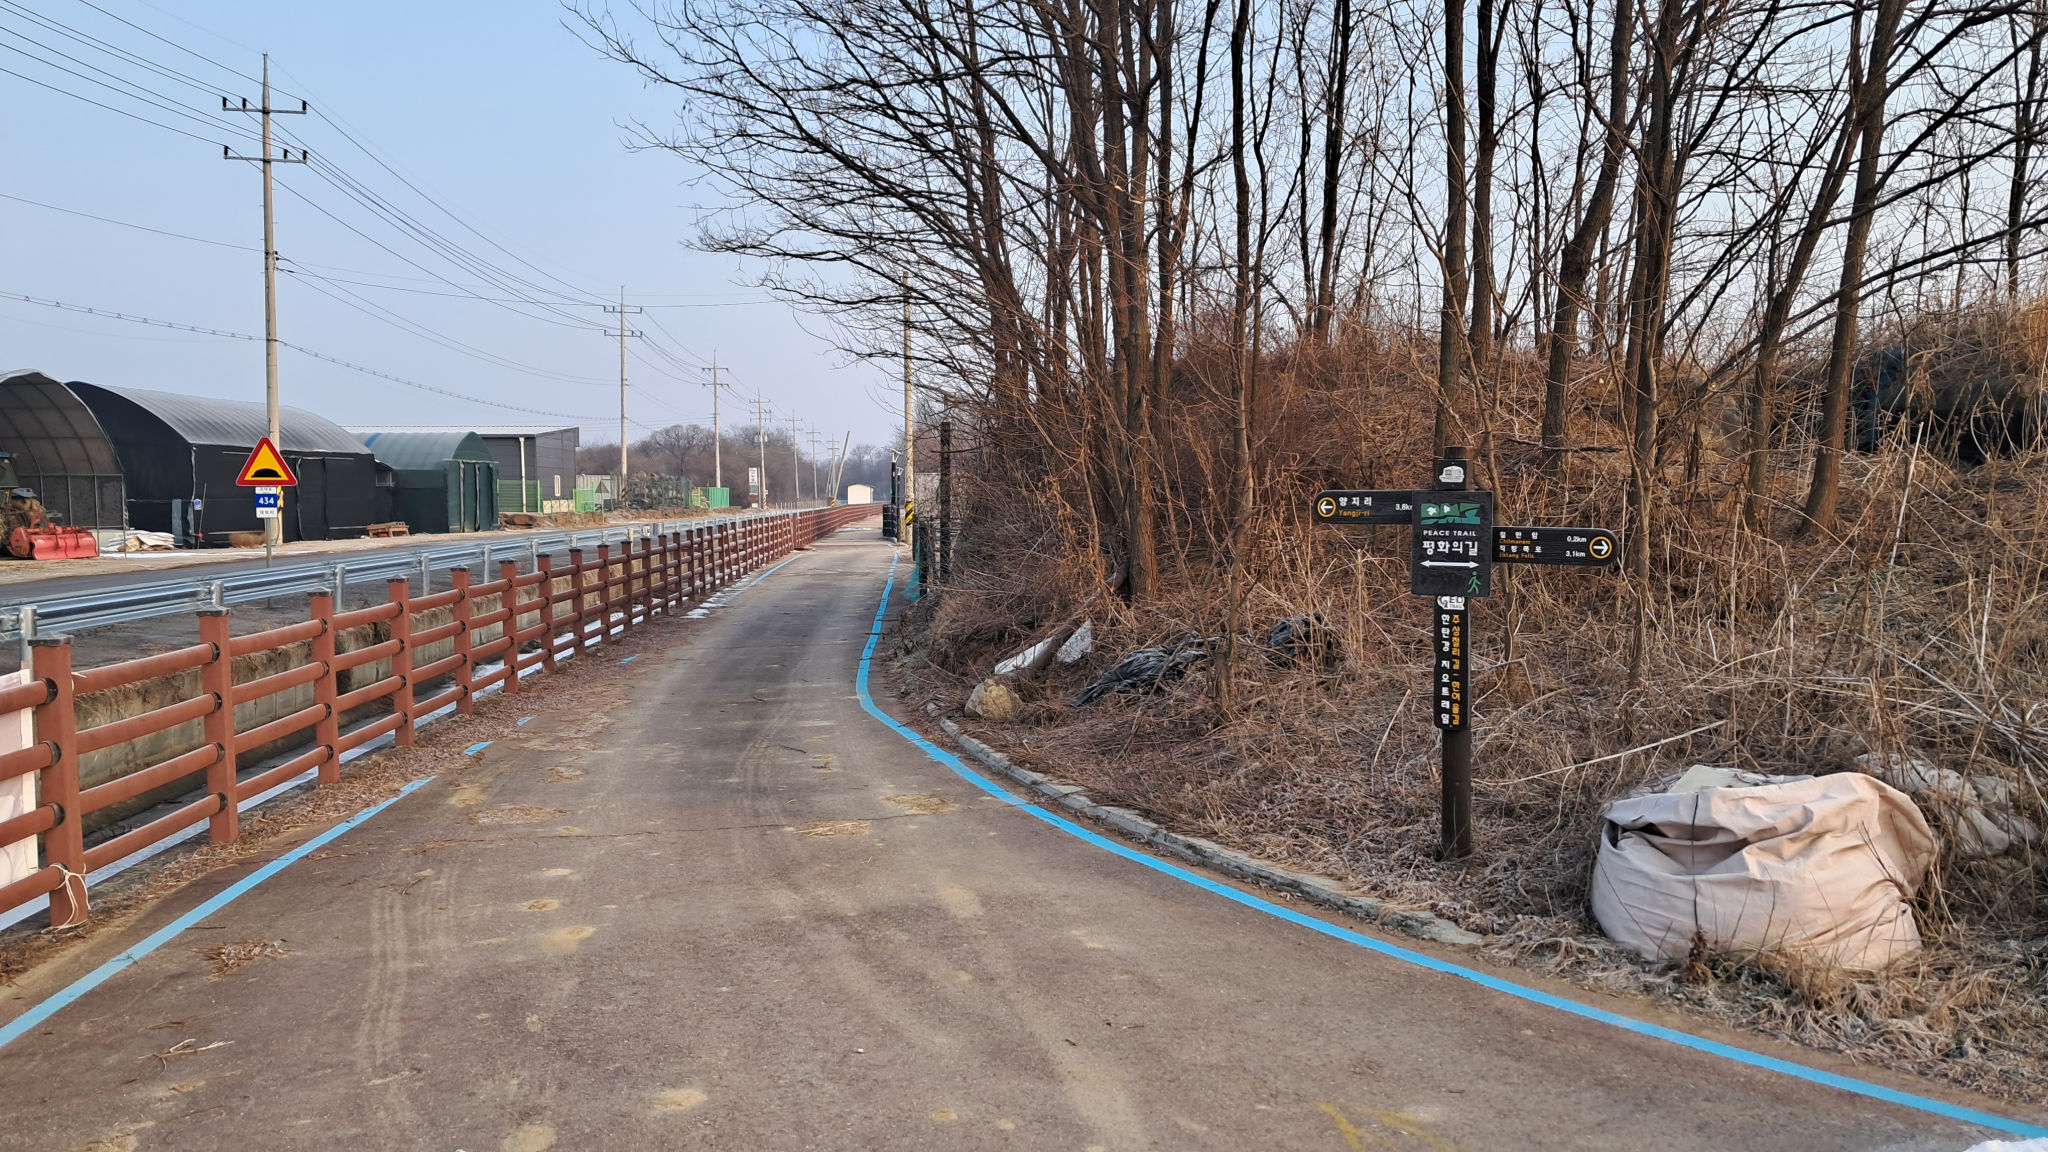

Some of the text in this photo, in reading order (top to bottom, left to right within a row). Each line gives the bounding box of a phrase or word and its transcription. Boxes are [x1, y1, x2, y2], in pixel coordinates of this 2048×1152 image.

[258, 496, 274, 505] 434
[1338, 496, 1372, 507] 양지리
[1338, 509, 1370, 518] Yangji-ri
[1423, 529, 1450, 537] PEACE
[1566, 535, 1587, 543] 0.2km
[1422, 540, 1479, 556] 평화의길
[1565, 550, 1586, 558] 3.1km
[1441, 613, 1450, 725] 한탄강 지오트레일
